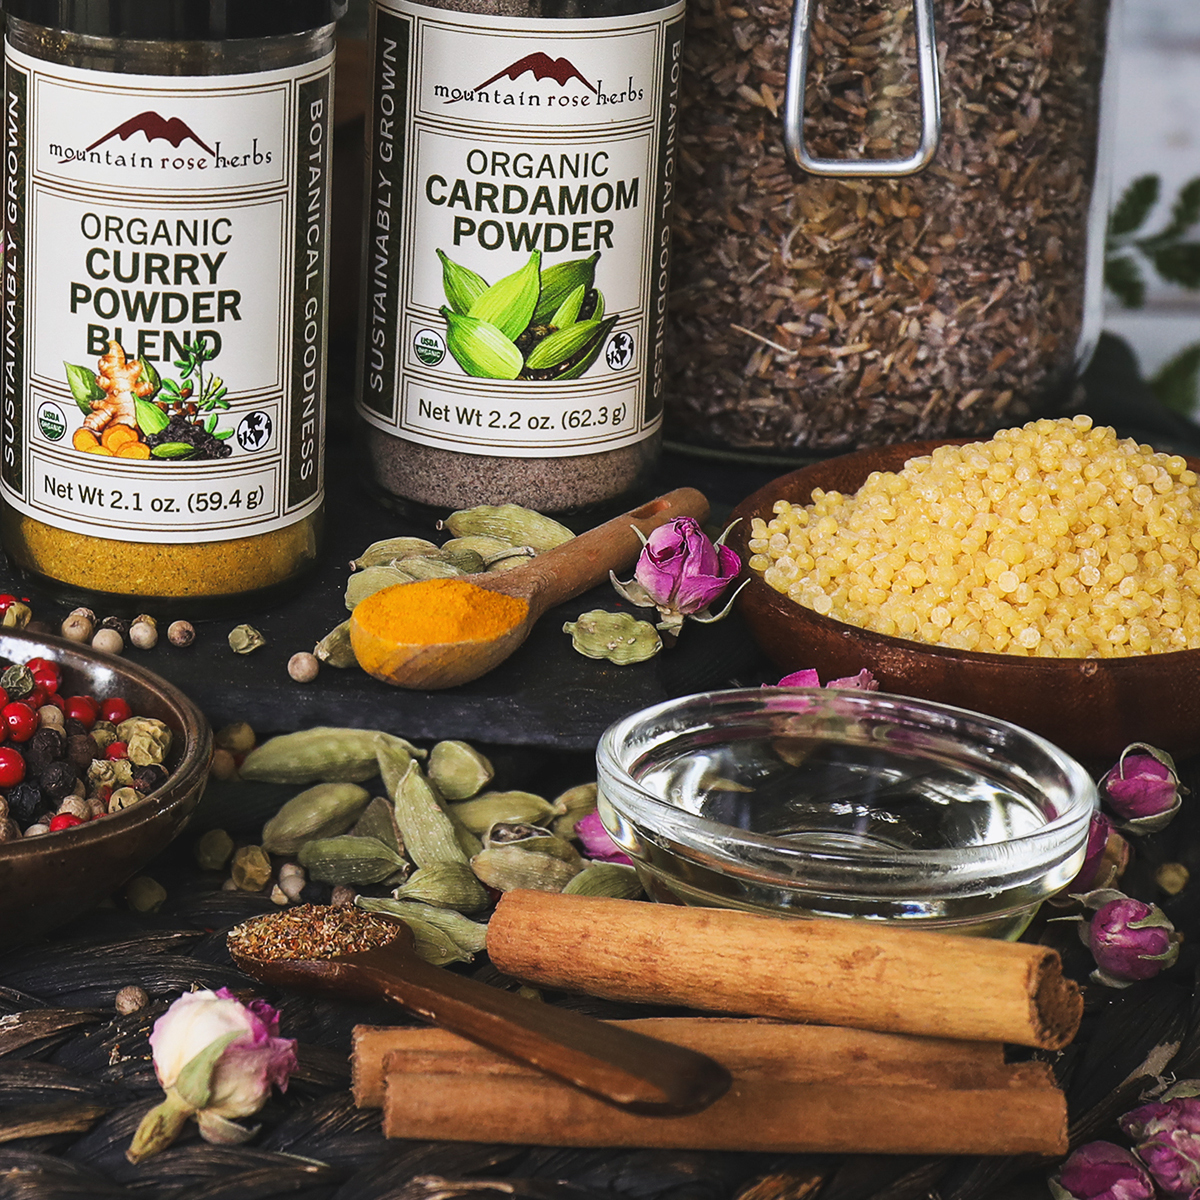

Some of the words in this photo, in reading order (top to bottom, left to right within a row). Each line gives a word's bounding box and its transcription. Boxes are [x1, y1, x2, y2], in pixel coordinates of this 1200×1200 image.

[379, 38, 397, 162] GROWN
[434, 83, 540, 106] mountain
[547, 94, 590, 106] rose
[596, 76, 643, 105] herbs
[661, 40, 680, 218] BOTANICAL
[5, 91, 20, 225] GROWN
[49, 143, 152, 169] mountain
[161, 157, 207, 170] rose
[214, 138, 272, 168] herbs
[466, 149, 609, 178] ORGANIC
[304, 98, 323, 290] BOTANICAL
[425, 175, 638, 216] CARDAMOM
[81, 212, 232, 246] ORGANIC
[453, 216, 614, 253] POWDER
[86, 247, 228, 285] CURRY
[370, 171, 392, 392] SUSTAINABLY
[70, 281, 242, 324] POWDER
[653, 225, 669, 398] GOODNESS
[3, 239, 19, 467] SUSTAINABLY
[87, 324, 222, 362] BLEND
[421, 336, 438, 348] USDA
[301, 298, 318, 481] GOODNESS
[418, 399, 450, 422] Net
[456, 405, 482, 427] Wt
[488, 411, 521, 430] 2.2
[527, 416, 554, 430] oz.
[561, 407, 609, 430] (62.3
[613, 402, 627, 425] g)
[44, 474, 73, 499] Net
[79, 483, 104, 507] Wt
[110, 490, 143, 511] 2.1
[150, 498, 180, 513] oz.
[187, 489, 242, 514] (59.4
[246, 485, 265, 509] g)
